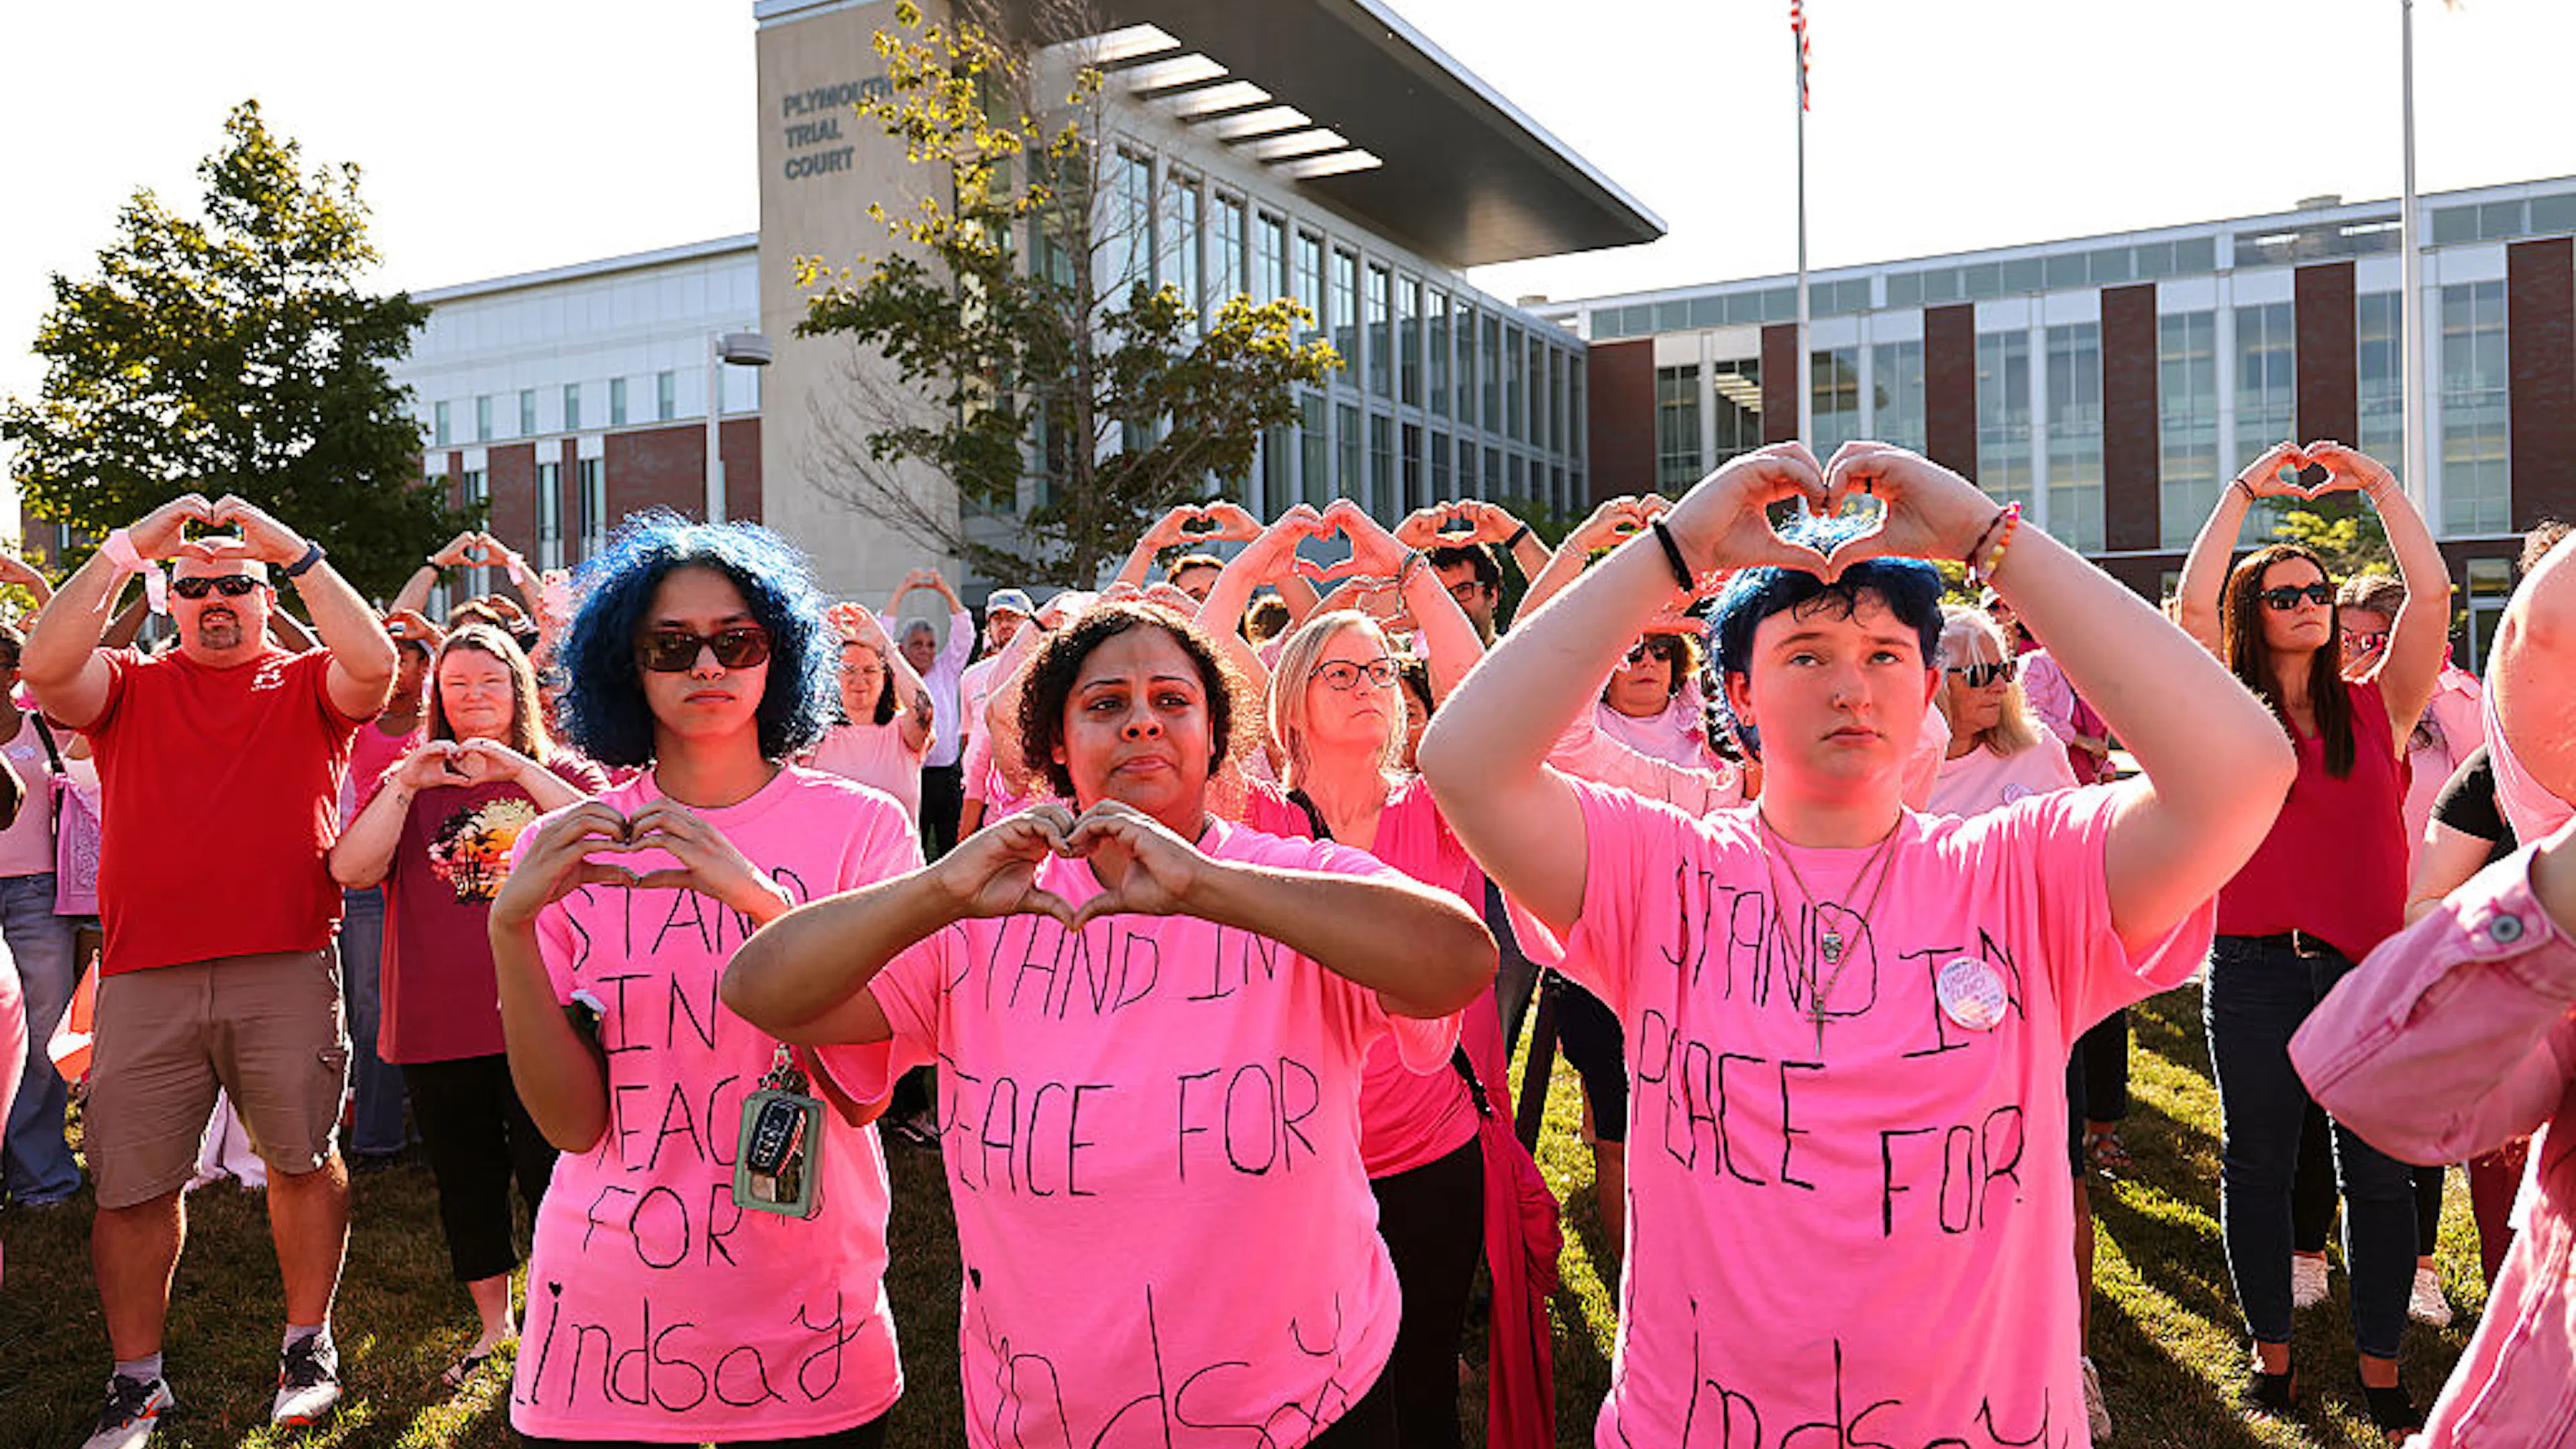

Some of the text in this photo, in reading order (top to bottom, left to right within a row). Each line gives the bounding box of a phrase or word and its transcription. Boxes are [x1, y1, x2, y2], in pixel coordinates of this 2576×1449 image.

[784, 118, 843, 148] TRIAL
[784, 146, 855, 180] COURT
[1187, 923, 1279, 1001] IN
[1660, 856, 2026, 1058] STAND IN
[596, 970, 718, 1054] IN
[596, 1074, 741, 1171] EAC
[1178, 1056, 1320, 1183] FOR
[1635, 1009, 2023, 1238] PEACE FOR
[584, 1184, 743, 1270] FOR
[515, 1281, 866, 1412] indsay
